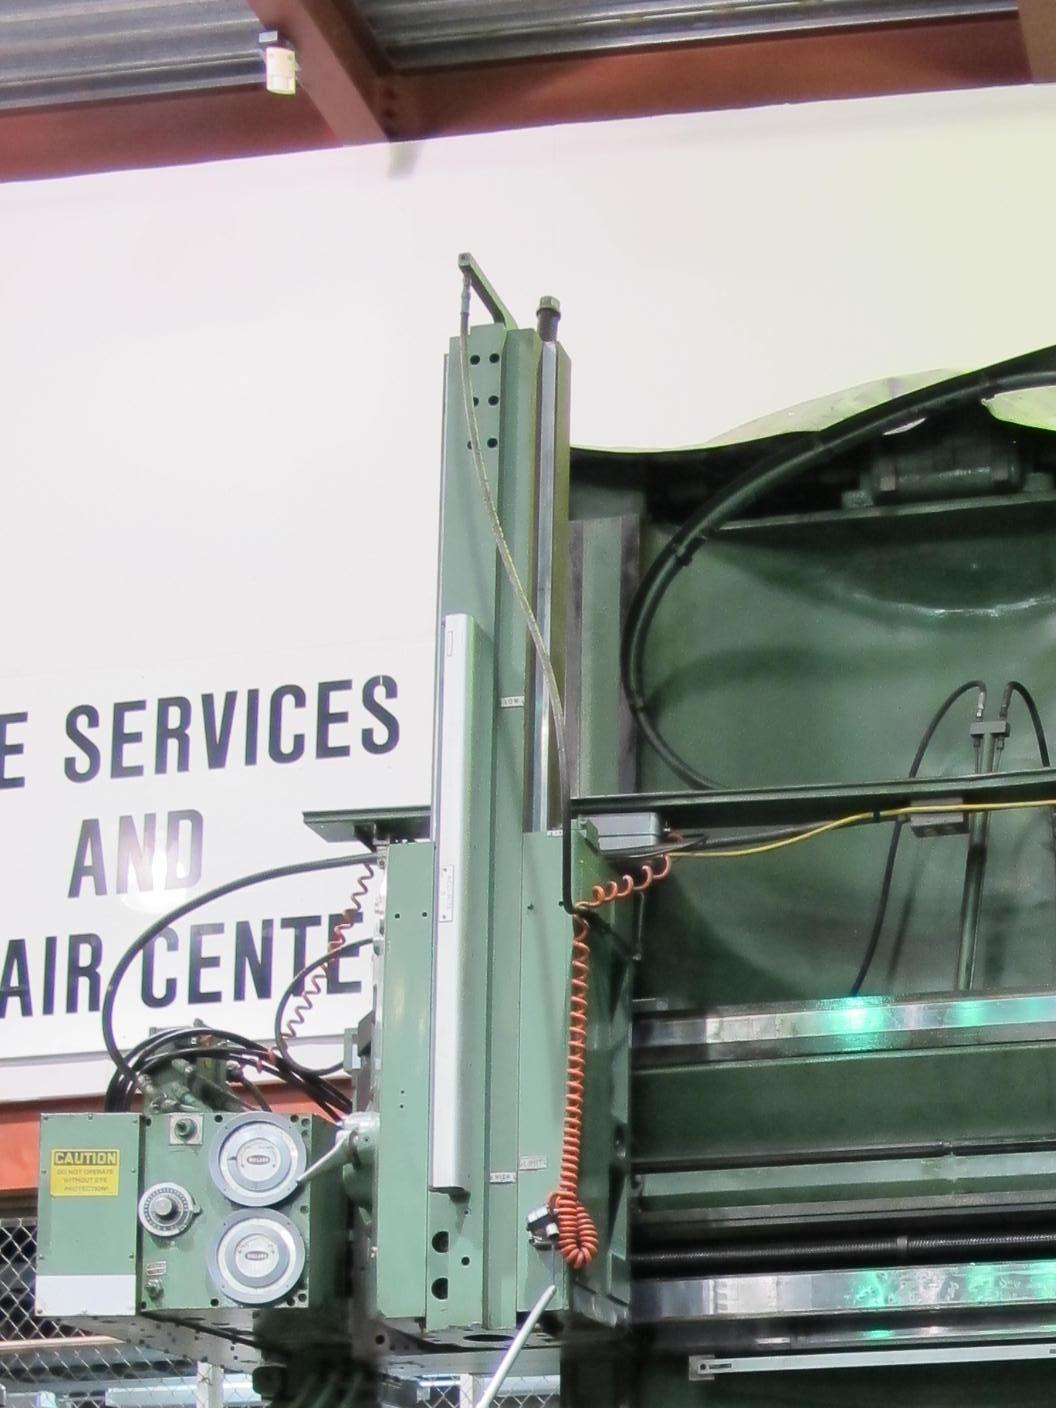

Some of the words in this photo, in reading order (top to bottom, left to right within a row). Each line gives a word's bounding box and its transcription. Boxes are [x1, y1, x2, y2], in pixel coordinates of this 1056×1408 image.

[63, 674, 401, 784] SERVICES
[67, 808, 205, 899] AND
[55, 1152, 116, 1165] CAUTION
